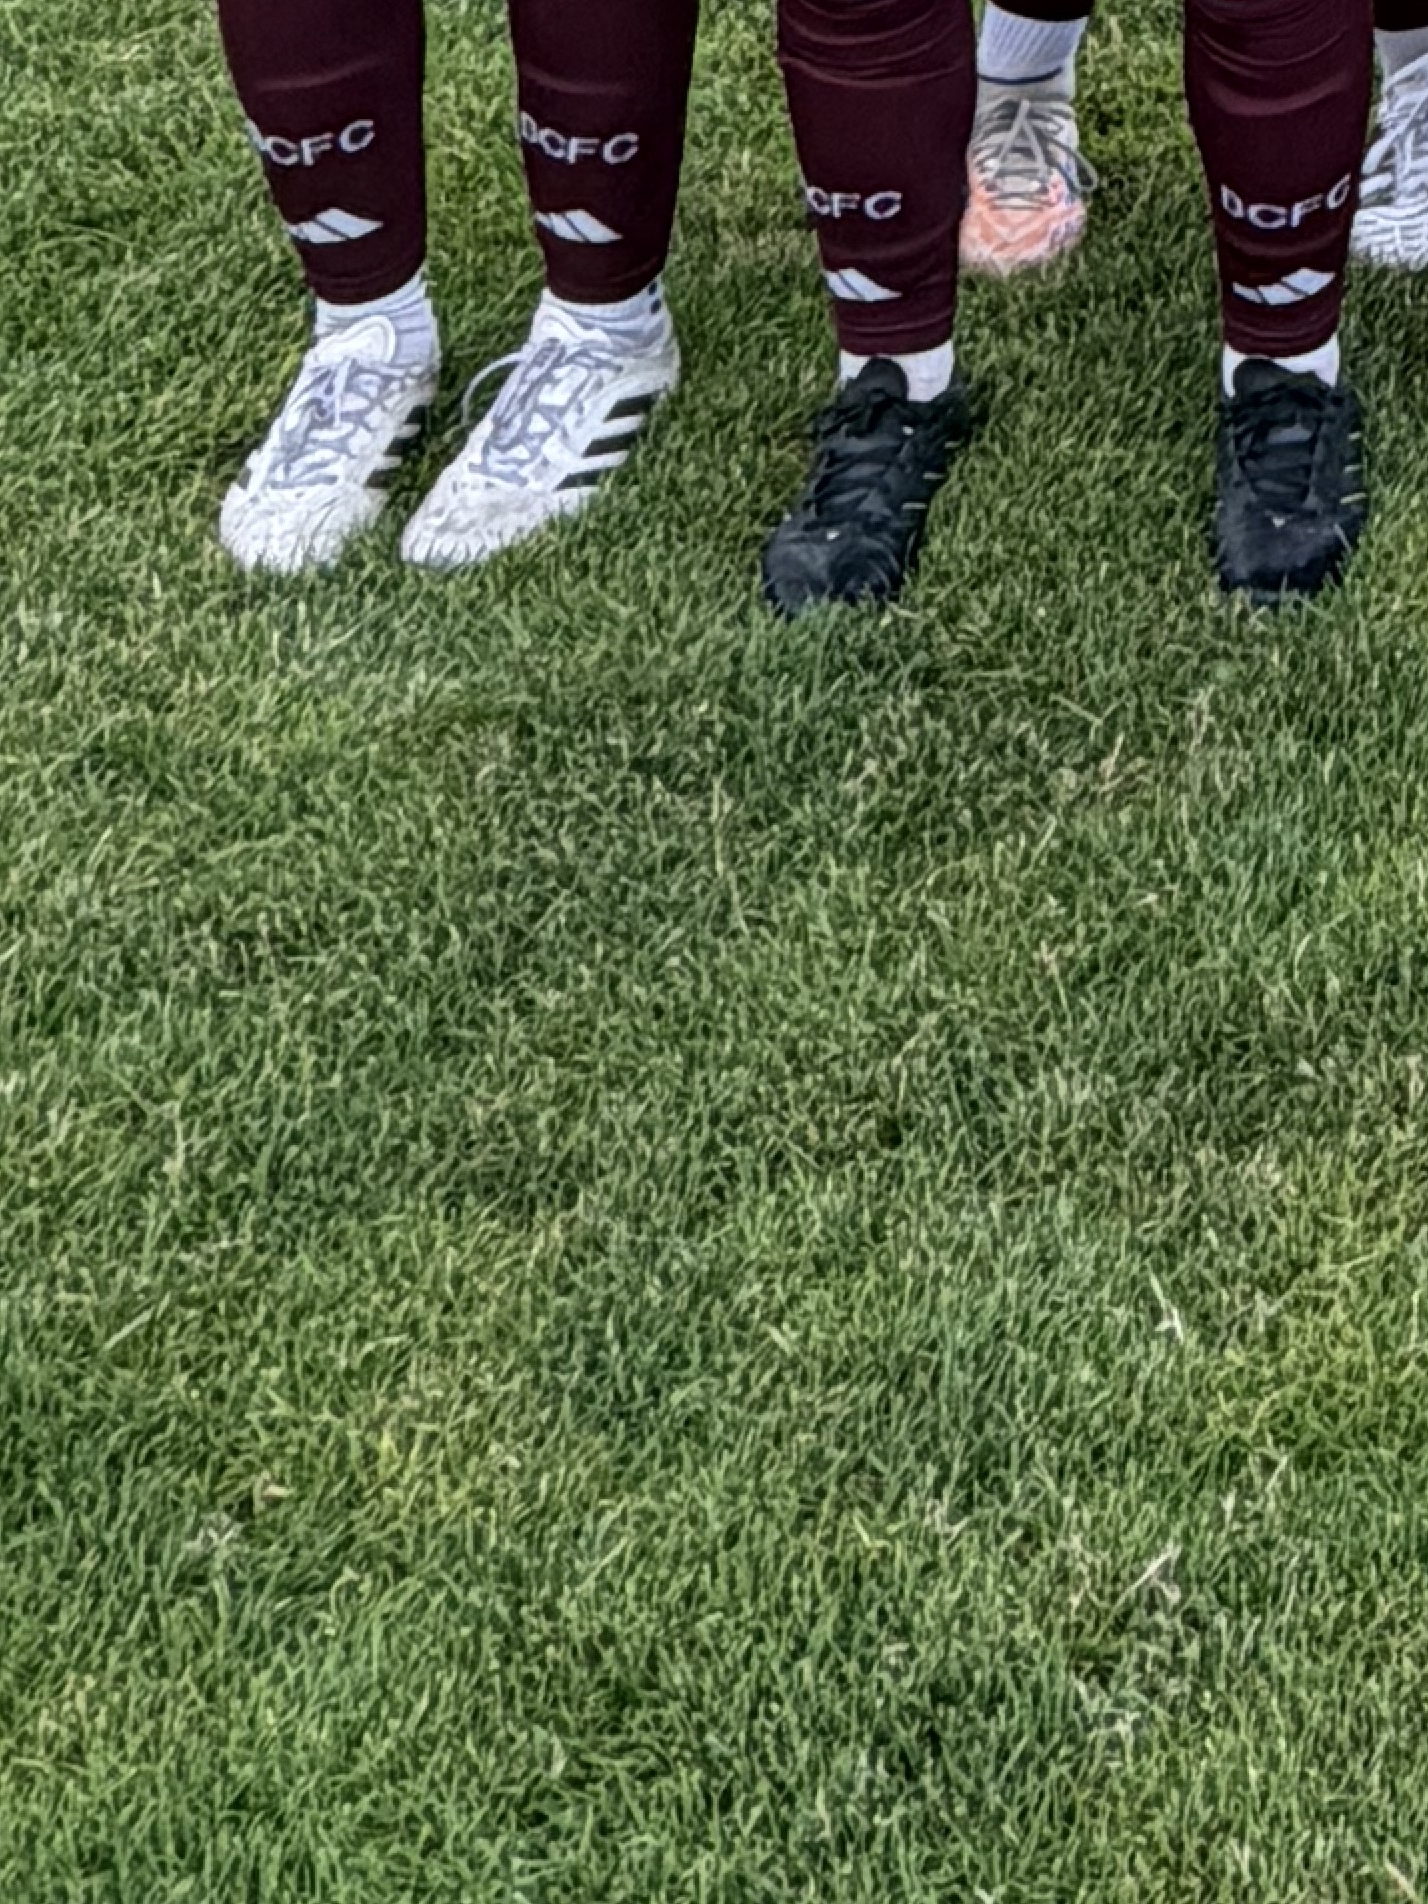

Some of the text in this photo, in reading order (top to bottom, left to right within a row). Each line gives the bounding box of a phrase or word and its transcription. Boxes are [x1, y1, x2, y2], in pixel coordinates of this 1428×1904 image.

[520, 110, 639, 164] DCFC
[805, 188, 902, 222] CFC
[1219, 173, 1351, 229] DCFC
